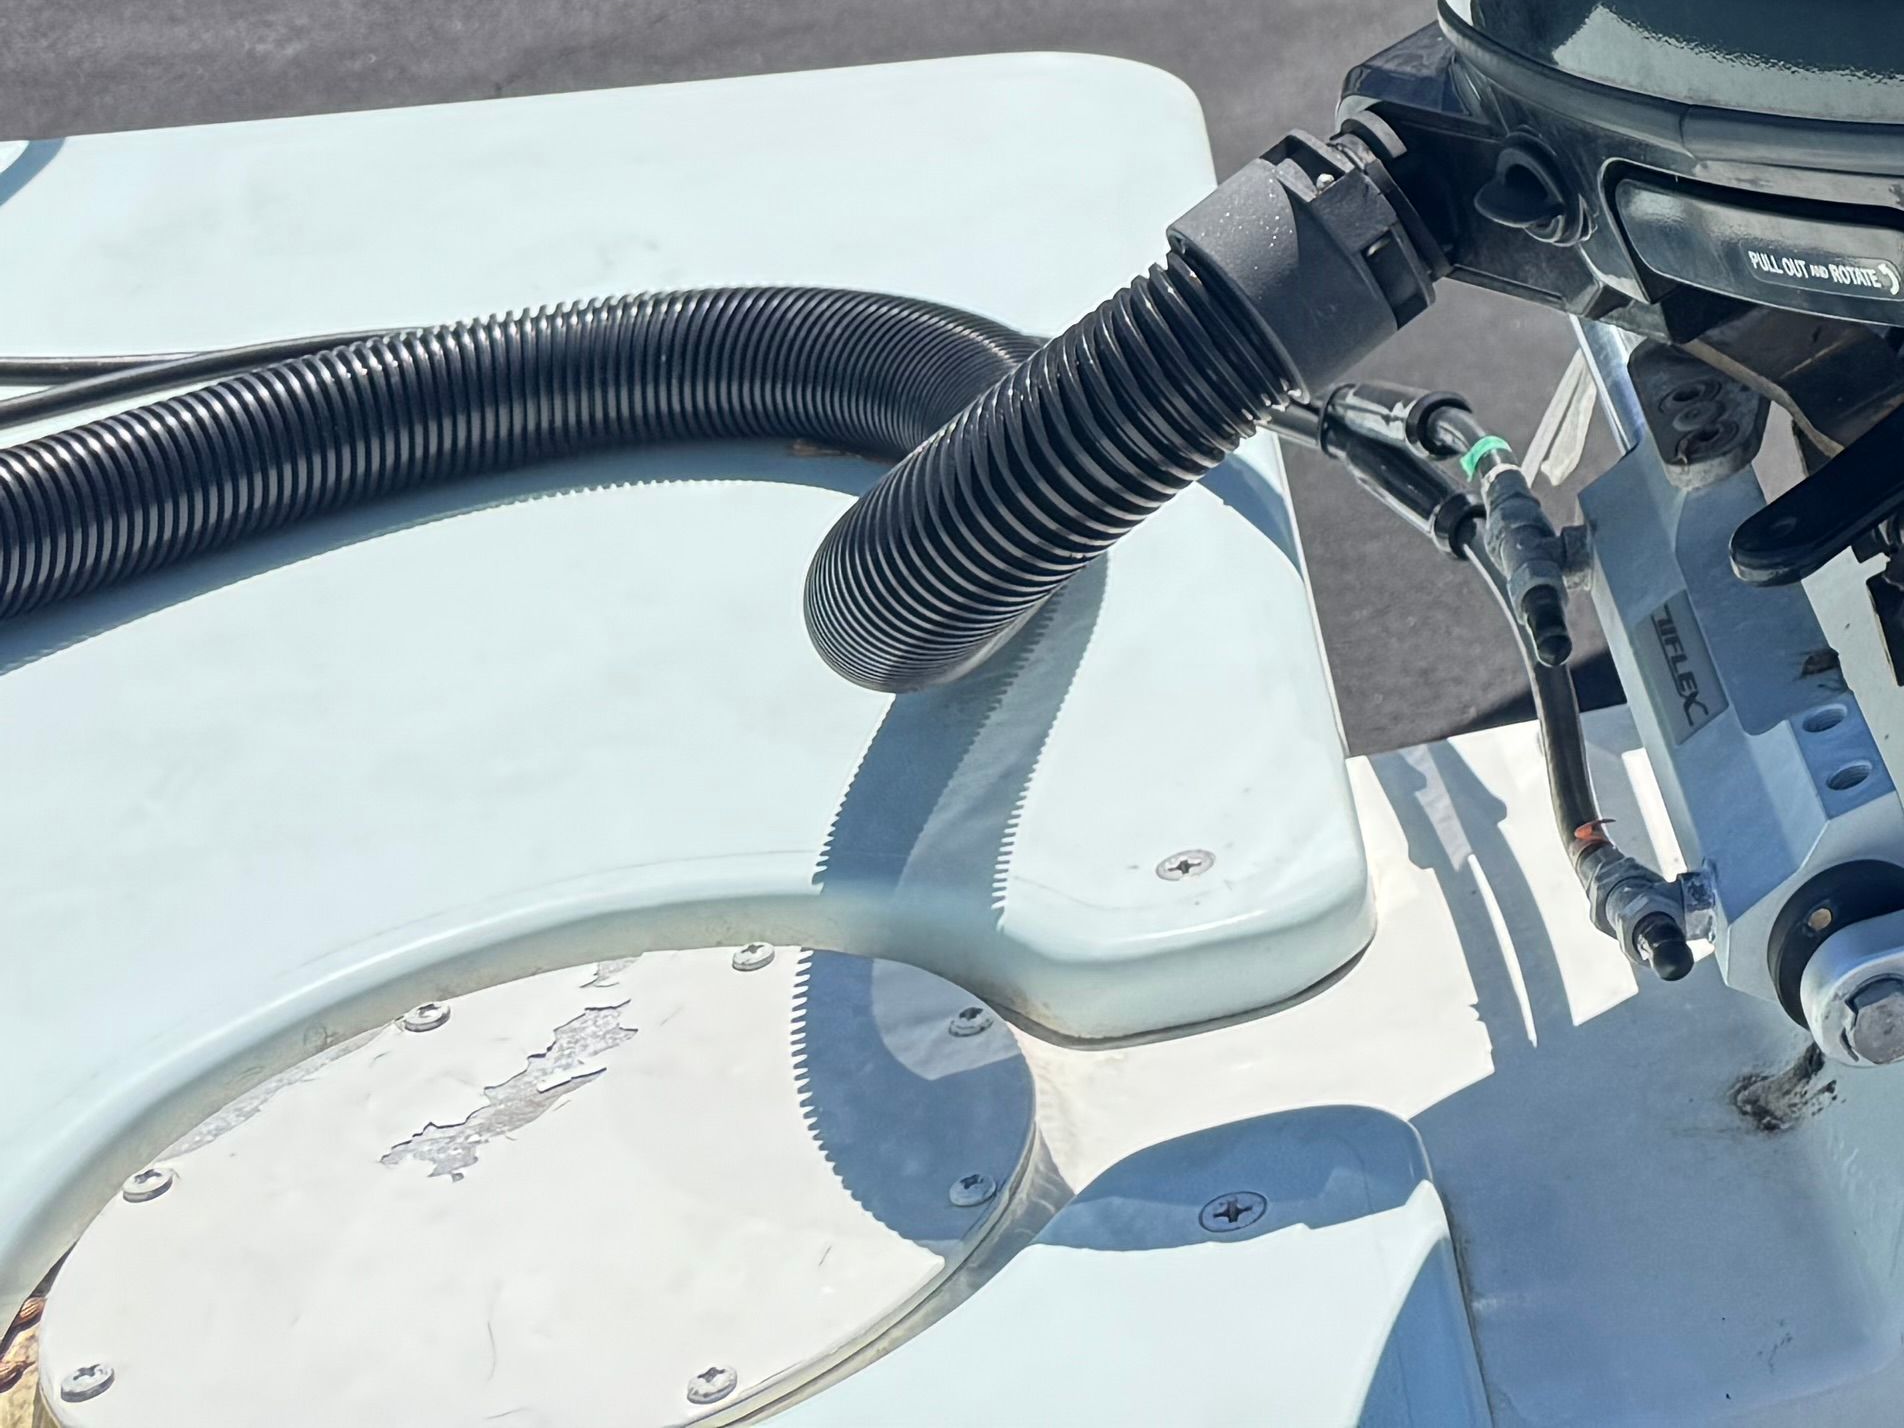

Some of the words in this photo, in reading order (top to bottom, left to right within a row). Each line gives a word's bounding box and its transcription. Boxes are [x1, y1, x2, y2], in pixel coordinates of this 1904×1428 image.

[1748, 250, 1783, 274] PULL
[1782, 258, 1808, 279] OUT
[1809, 264, 1829, 279] AND
[1828, 263, 1881, 288] ROTATE
